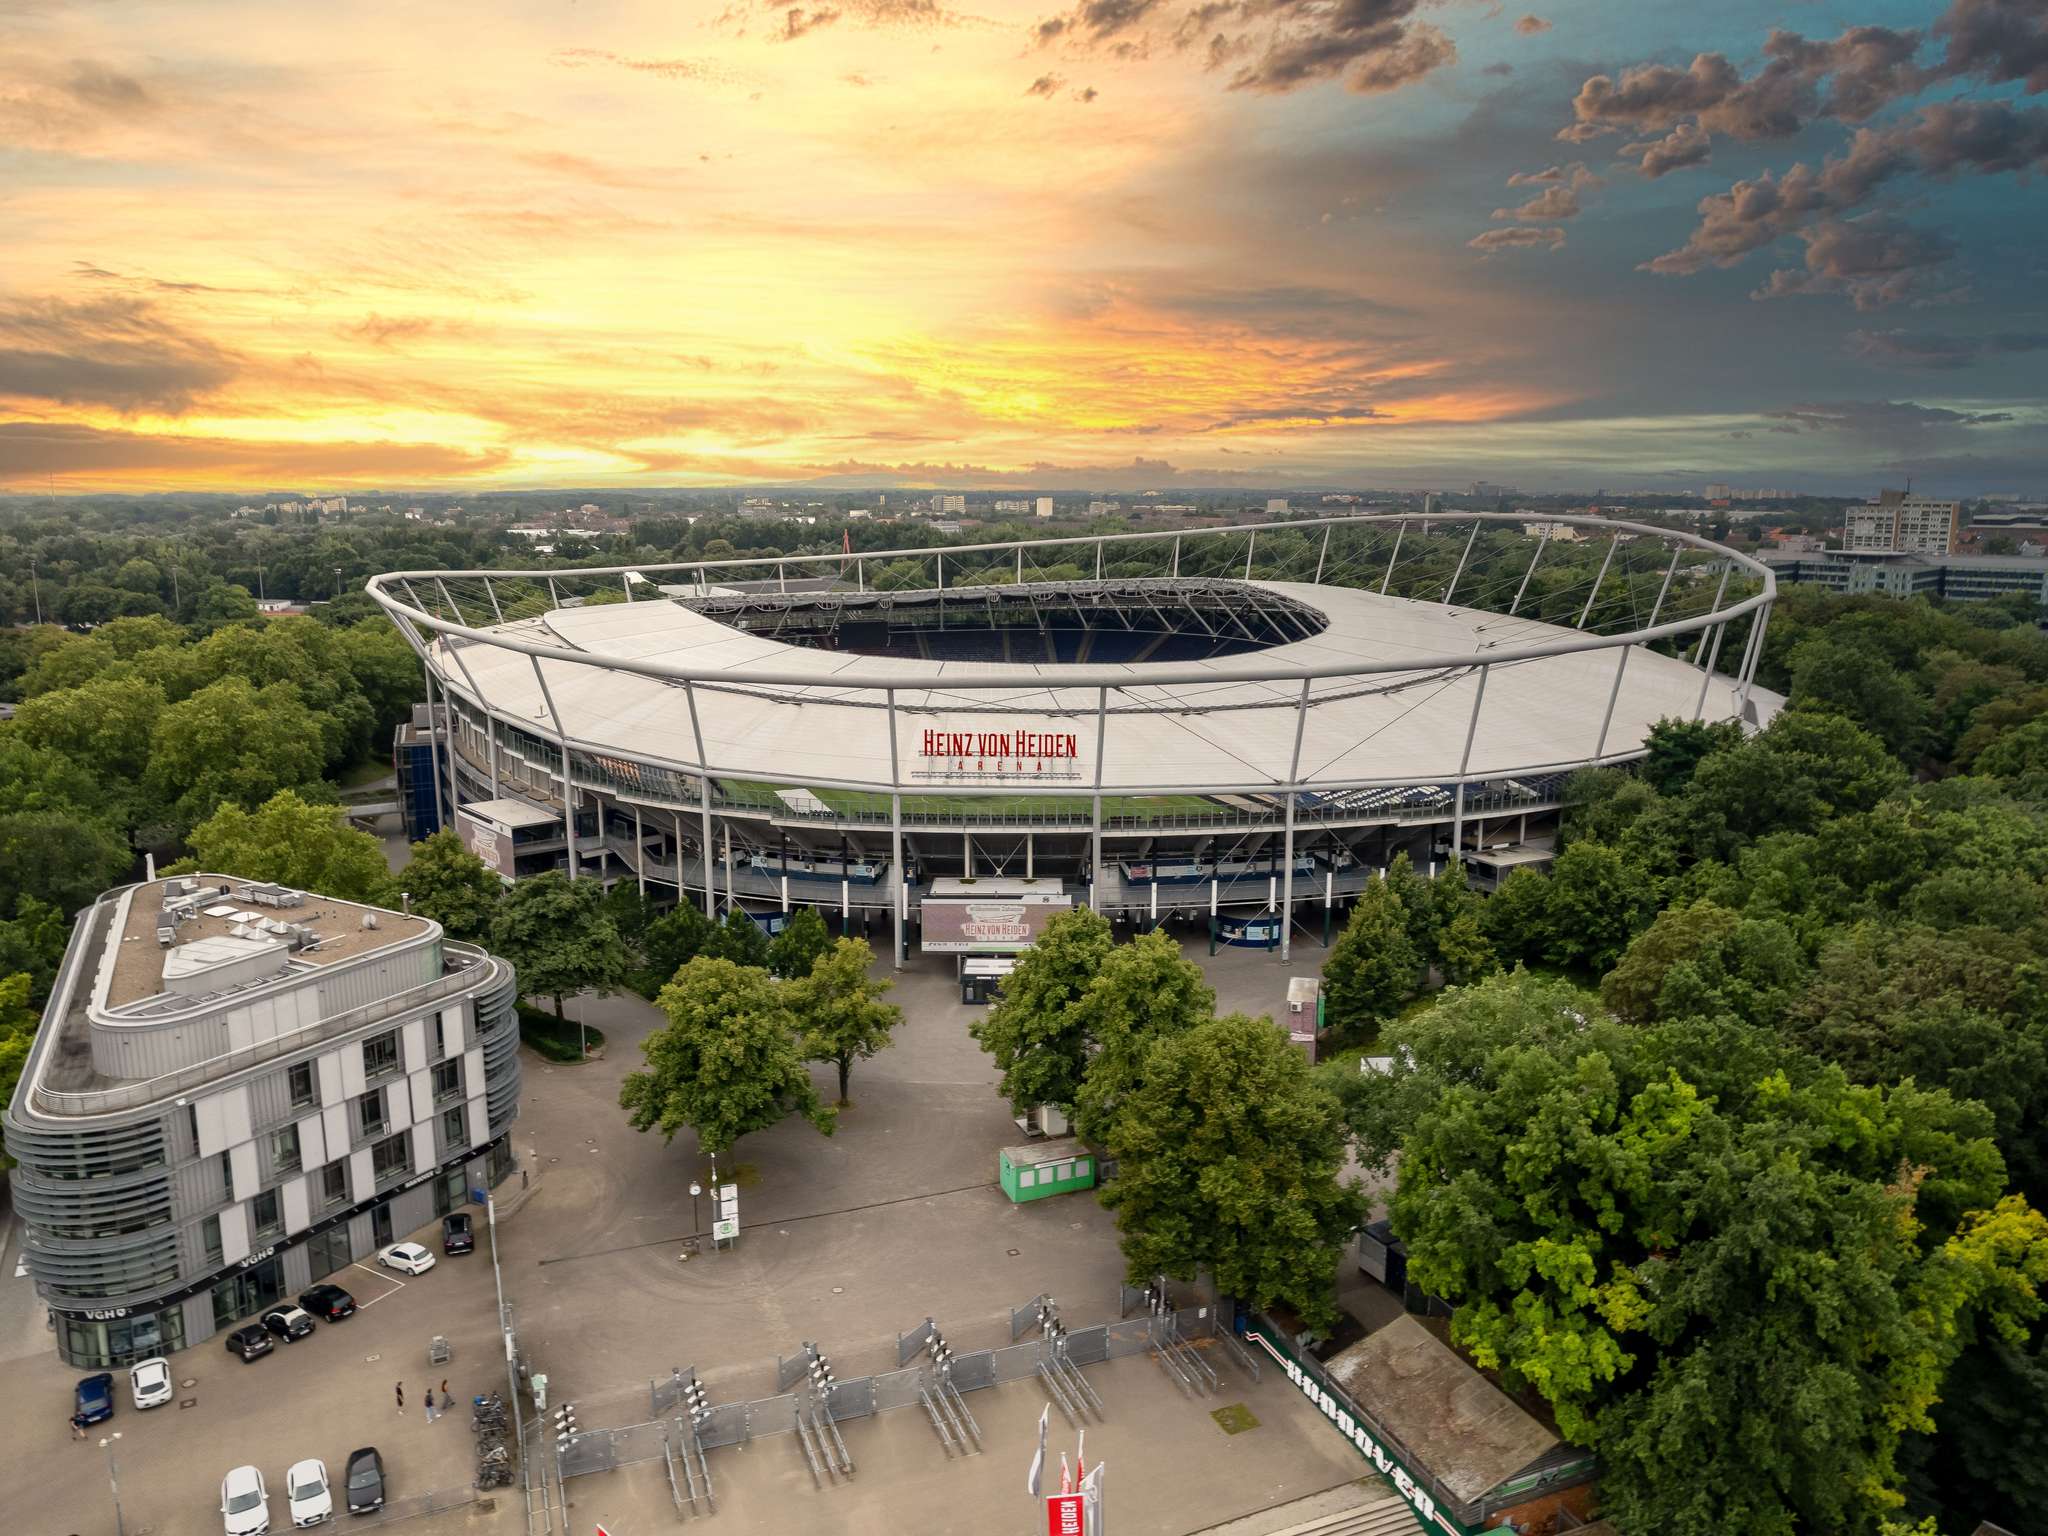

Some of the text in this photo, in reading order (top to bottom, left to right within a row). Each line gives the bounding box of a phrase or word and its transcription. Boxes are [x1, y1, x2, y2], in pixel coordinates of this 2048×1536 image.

[924, 729, 1077, 758] HEINZ VON HEIDEN
[958, 761, 1042, 772] ARENA
[965, 924, 986, 936] HEINZ
[1001, 924, 1027, 936] HEIDEN
[239, 1250, 266, 1268] VGH
[85, 1310, 115, 1320] VGH
[1060, 1501, 1080, 1534] HEIDEN
